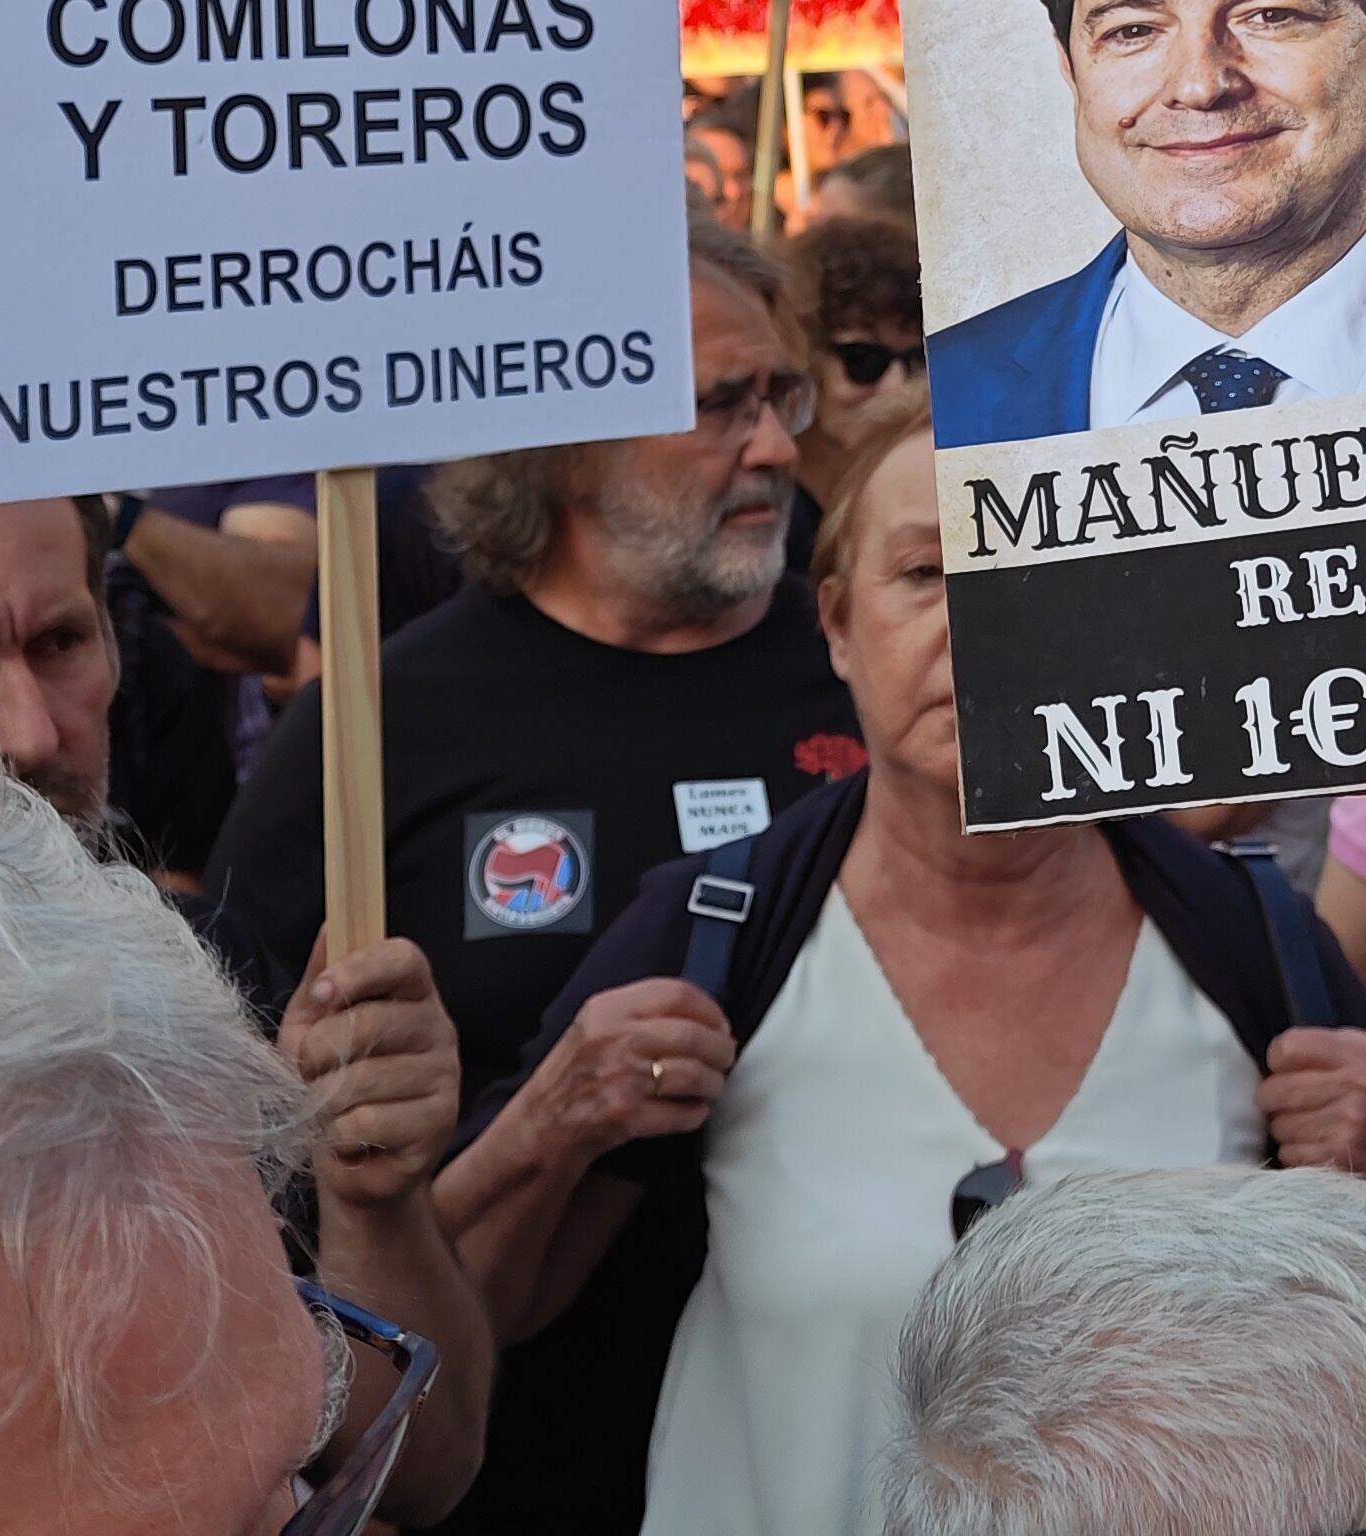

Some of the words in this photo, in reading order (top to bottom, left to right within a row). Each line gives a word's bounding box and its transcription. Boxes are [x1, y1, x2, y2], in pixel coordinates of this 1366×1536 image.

[58, 99, 123, 181] Y
[151, 80, 587, 177] TOREROS
[114, 221, 544, 317] DERROCHÁIS
[385, 328, 656, 409] DINEROS
[1032, 686, 1195, 802] NI
